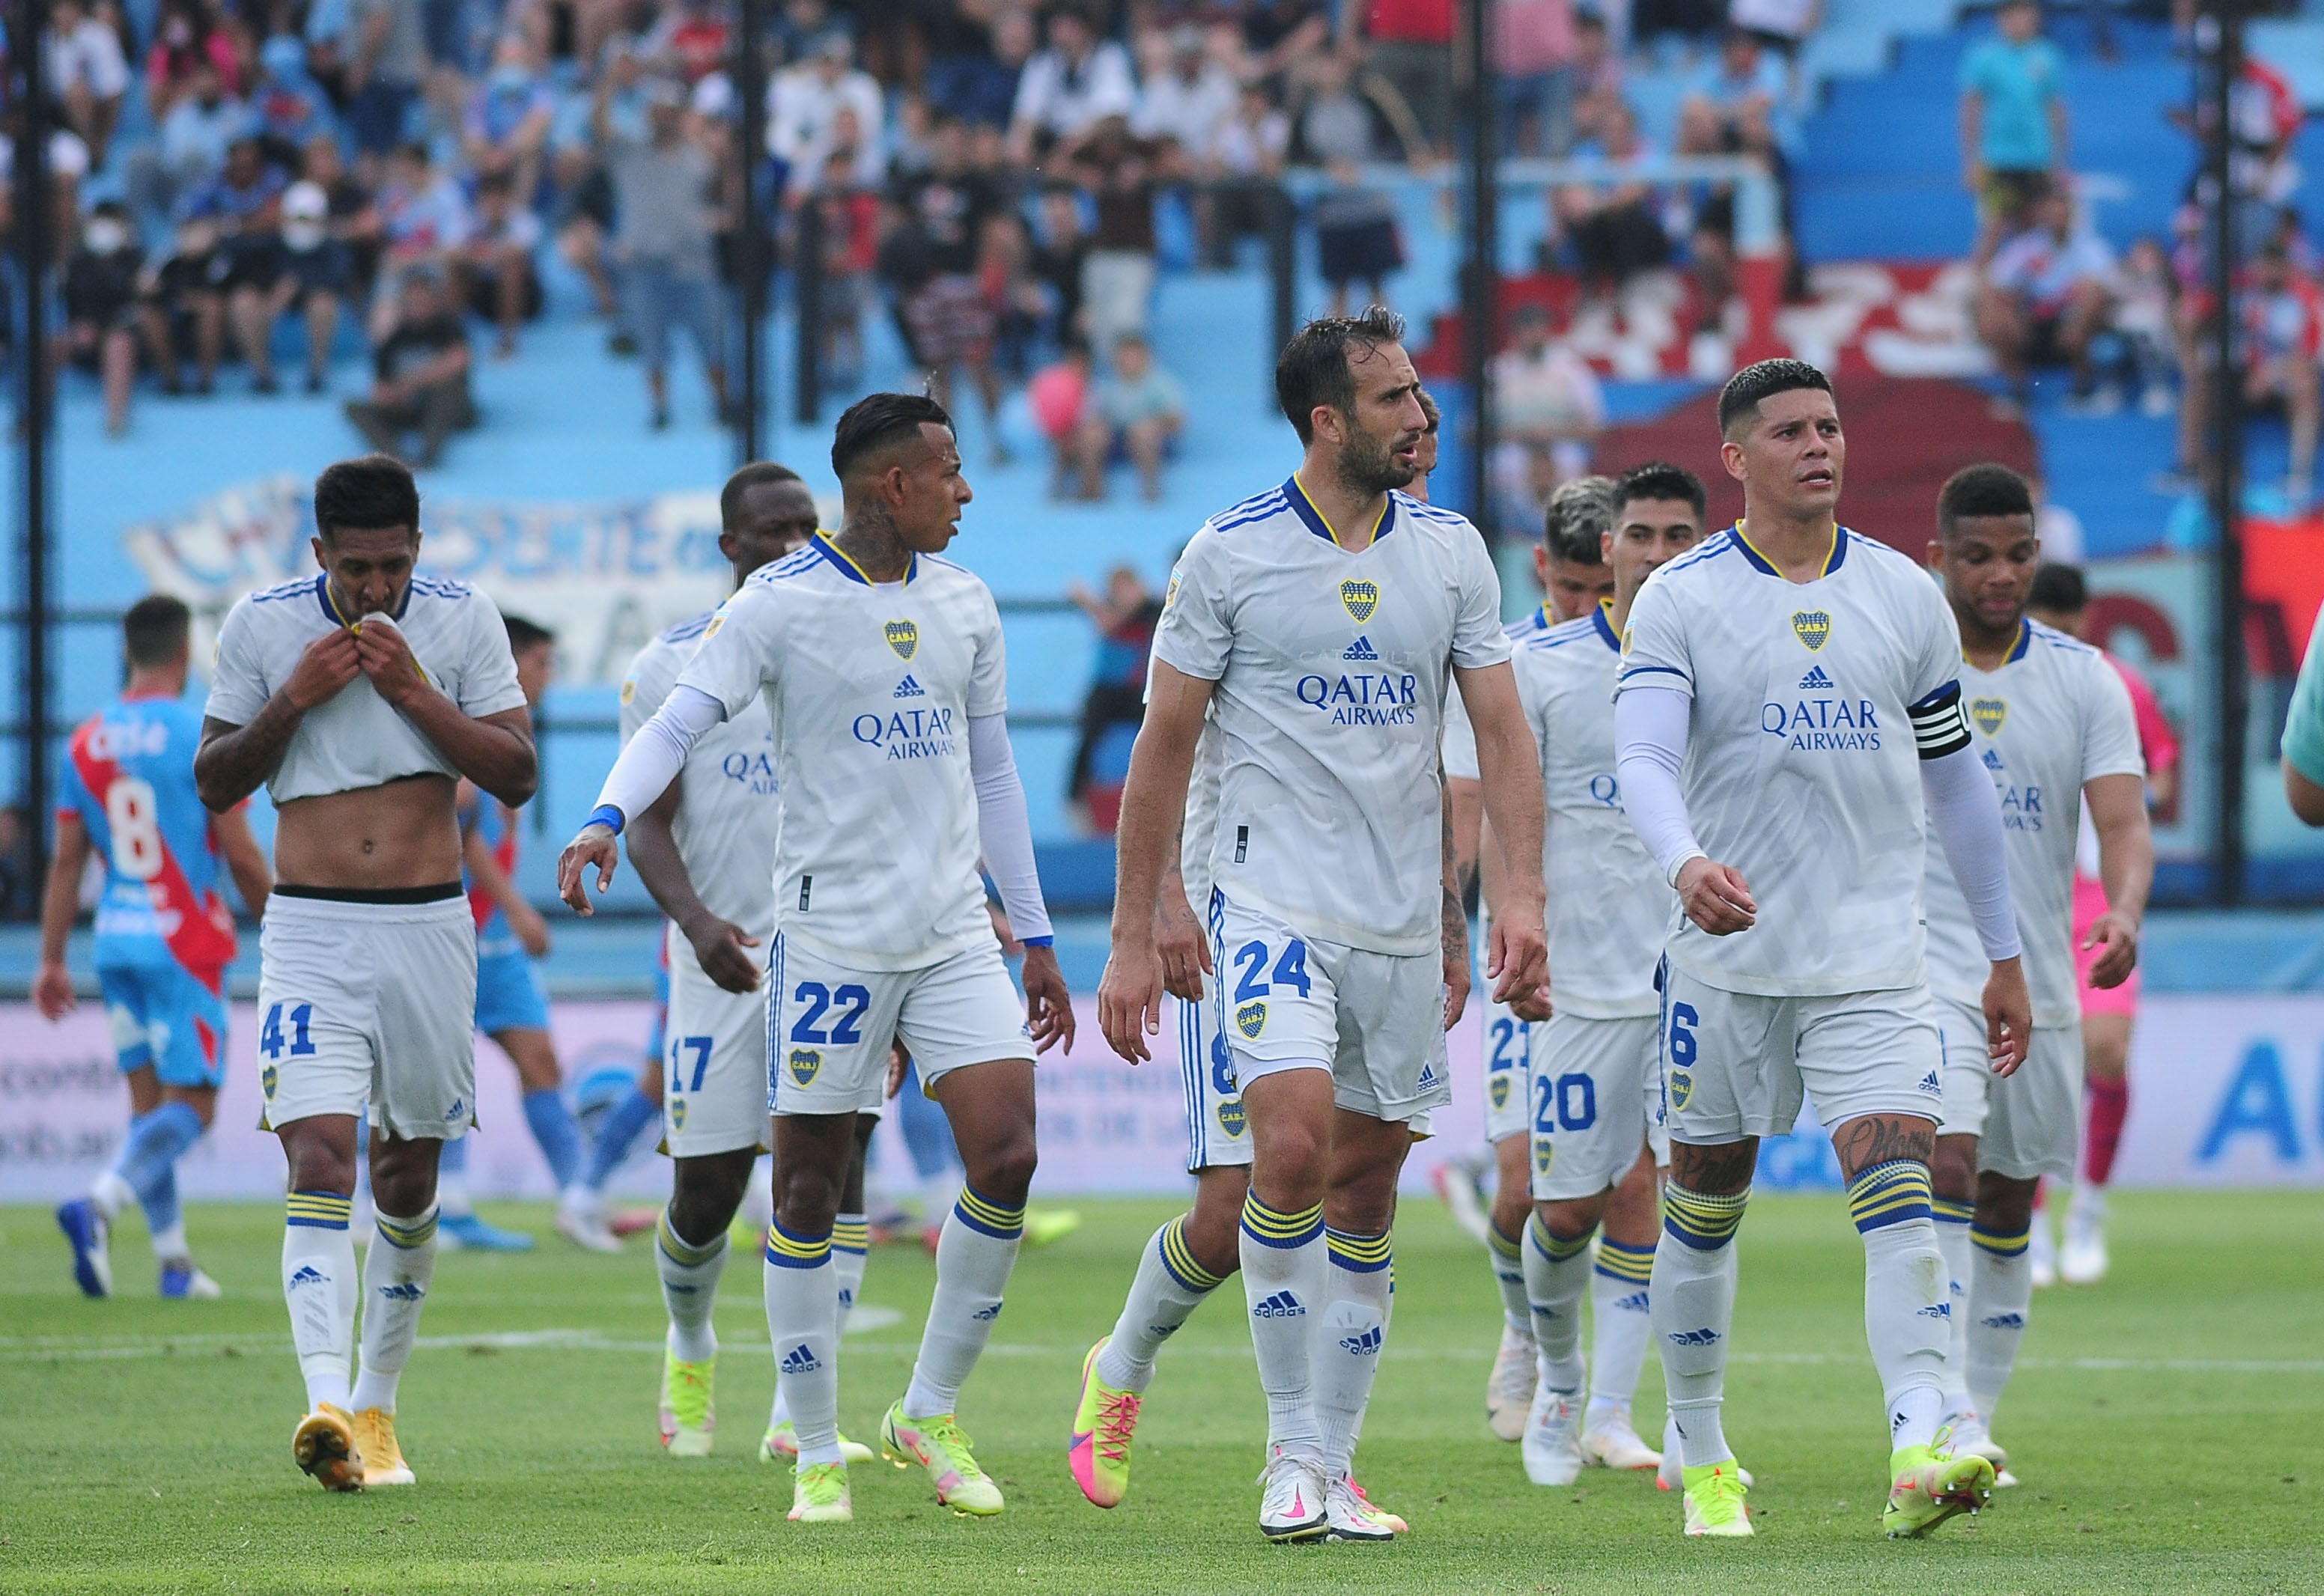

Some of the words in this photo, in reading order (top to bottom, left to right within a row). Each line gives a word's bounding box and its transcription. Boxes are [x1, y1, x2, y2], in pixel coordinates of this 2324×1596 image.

[1345, 593, 1375, 603] CABJ
[888, 630, 916, 643] CABJ
[1797, 623, 1828, 633] CABJ
[1342, 650, 1378, 660] adidas
[893, 687, 925, 698] adidas
[1296, 674, 1416, 710] QATAR
[1798, 678, 1834, 689] adidas
[1331, 706, 1415, 726] AIRWAYS
[1762, 699, 1879, 738] QATAR
[853, 708, 952, 747] QATAR
[1790, 732, 1881, 751] AIRWAYS
[723, 752, 773, 783] QA
[752, 781, 779, 795] AIR
[107, 779, 163, 879] 8
[1234, 939, 1311, 1005] 24
[791, 981, 871, 1045] 22
[1239, 1012, 1263, 1026] CABJ
[261, 1003, 316, 1059] 41
[1670, 1001, 1699, 1067] 6
[672, 1036, 713, 1092] 17
[792, 1060, 817, 1070] CABJ
[1417, 1078, 1440, 1091] adidas
[1536, 1072, 1596, 1133] 20
[1253, 1307, 1307, 1318] adidas
[1339, 1339, 1381, 1356] adida
[782, 1359, 822, 1374] adidas
